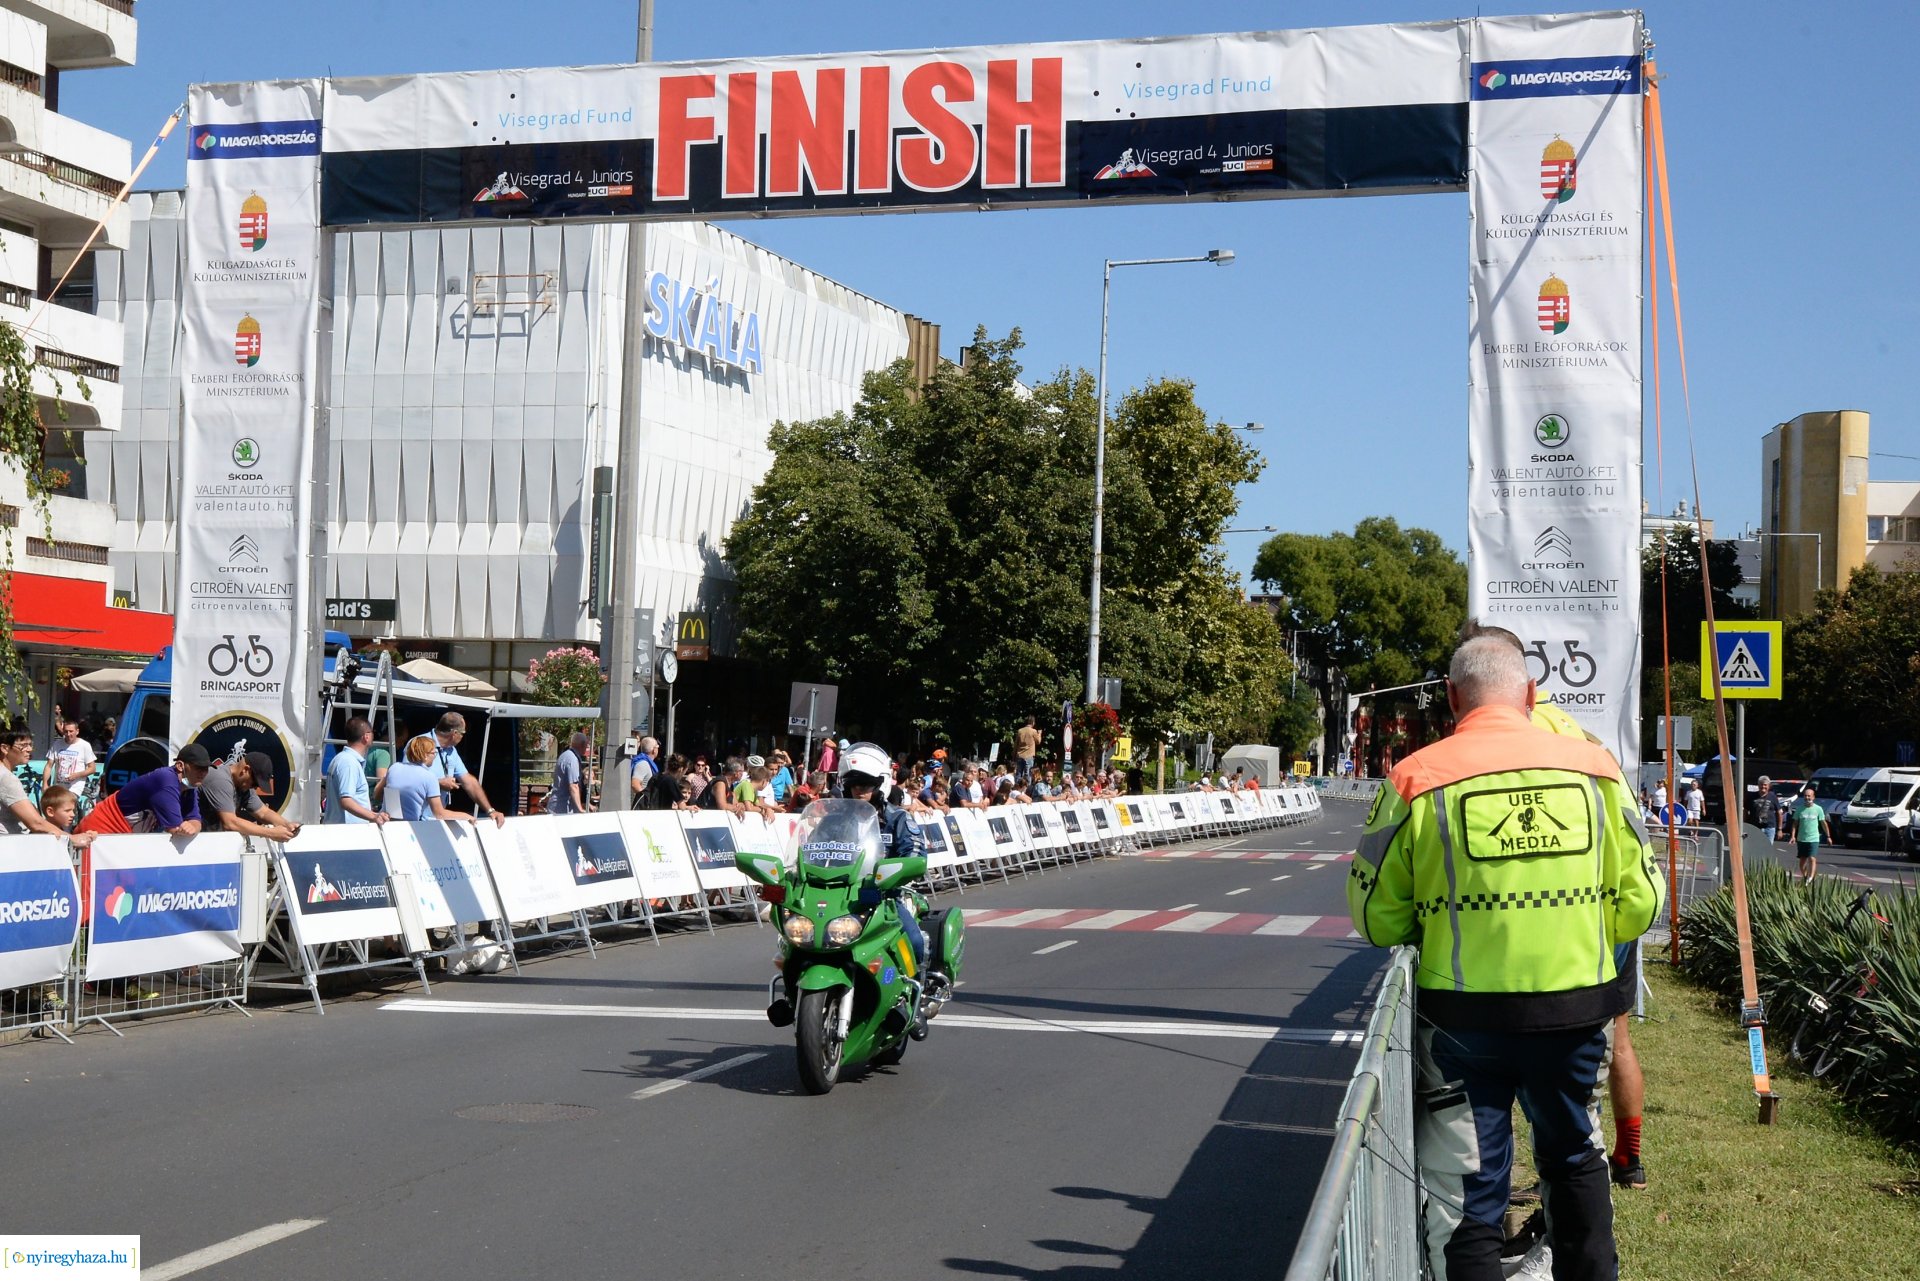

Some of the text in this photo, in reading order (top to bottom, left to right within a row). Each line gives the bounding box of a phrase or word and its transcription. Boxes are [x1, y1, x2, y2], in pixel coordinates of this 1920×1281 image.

[1510, 66, 1632, 86] MAGYARORSZÁG
[1124, 76, 1271, 100] Visegrad Fund
[498, 107, 632, 130] Visegrad Fund
[655, 57, 1064, 199] FINISH
[220, 130, 316, 148] MAGYARORSZÁG
[1136, 142, 1273, 166] Visegrad 4 Juniors
[1226, 161, 1244, 171] UCI
[509, 170, 634, 189] Visegrad 4 Juniors
[592, 186, 608, 196] UCI
[1500, 210, 1613, 224] KÜLGAZDASÁGI ÉS
[1485, 225, 1628, 239] KÜLÜGYMINISZTÉRIUM
[207, 258, 296, 270] KÜLGAZDASÁGI ÉS
[194, 271, 307, 282] KÜLÜGYMINISZTÉRIUM
[646, 272, 763, 375] SKÁLA
[1484, 340, 1629, 354] EMBERI ERŐFORRÁSOK
[1502, 356, 1608, 369] MINISZTÉRIUMA
[191, 373, 228, 384] EMBERI
[206, 386, 290, 396] MINISZTÉRIUMA
[1530, 454, 1575, 462] ŠKODA
[228, 472, 264, 481] ŠKODA
[1491, 464, 1616, 480] VALENT AUTÓ KFT.
[196, 485, 238, 495] VALENT
[240, 482, 270, 494] AUTÓ
[1492, 484, 1614, 498] valentauto.hu
[195, 500, 294, 512] valentauto.hu
[218, 565, 268, 574] CITROËN
[1522, 561, 1584, 570] CITROËN
[190, 580, 294, 595] CITROËN VALENT
[1486, 578, 1618, 594] CITROËN VALENT
[190, 601, 294, 611] citroenvalent.hu
[1488, 601, 1618, 612] citroenvalent.hu
[200, 680, 281, 693] BRINGASPORT
[212, 718, 267, 735] VISEGRAD 4 JUNIORS
[1508, 792, 1545, 807] UBE
[803, 840, 862, 852] RENDŐRSÉG
[1500, 834, 1562, 852] MEDIA
[810, 852, 852, 861] POLICE
[413, 858, 482, 888] Visegrad Fund
[137, 882, 238, 914] MAGYARORSZÁG
